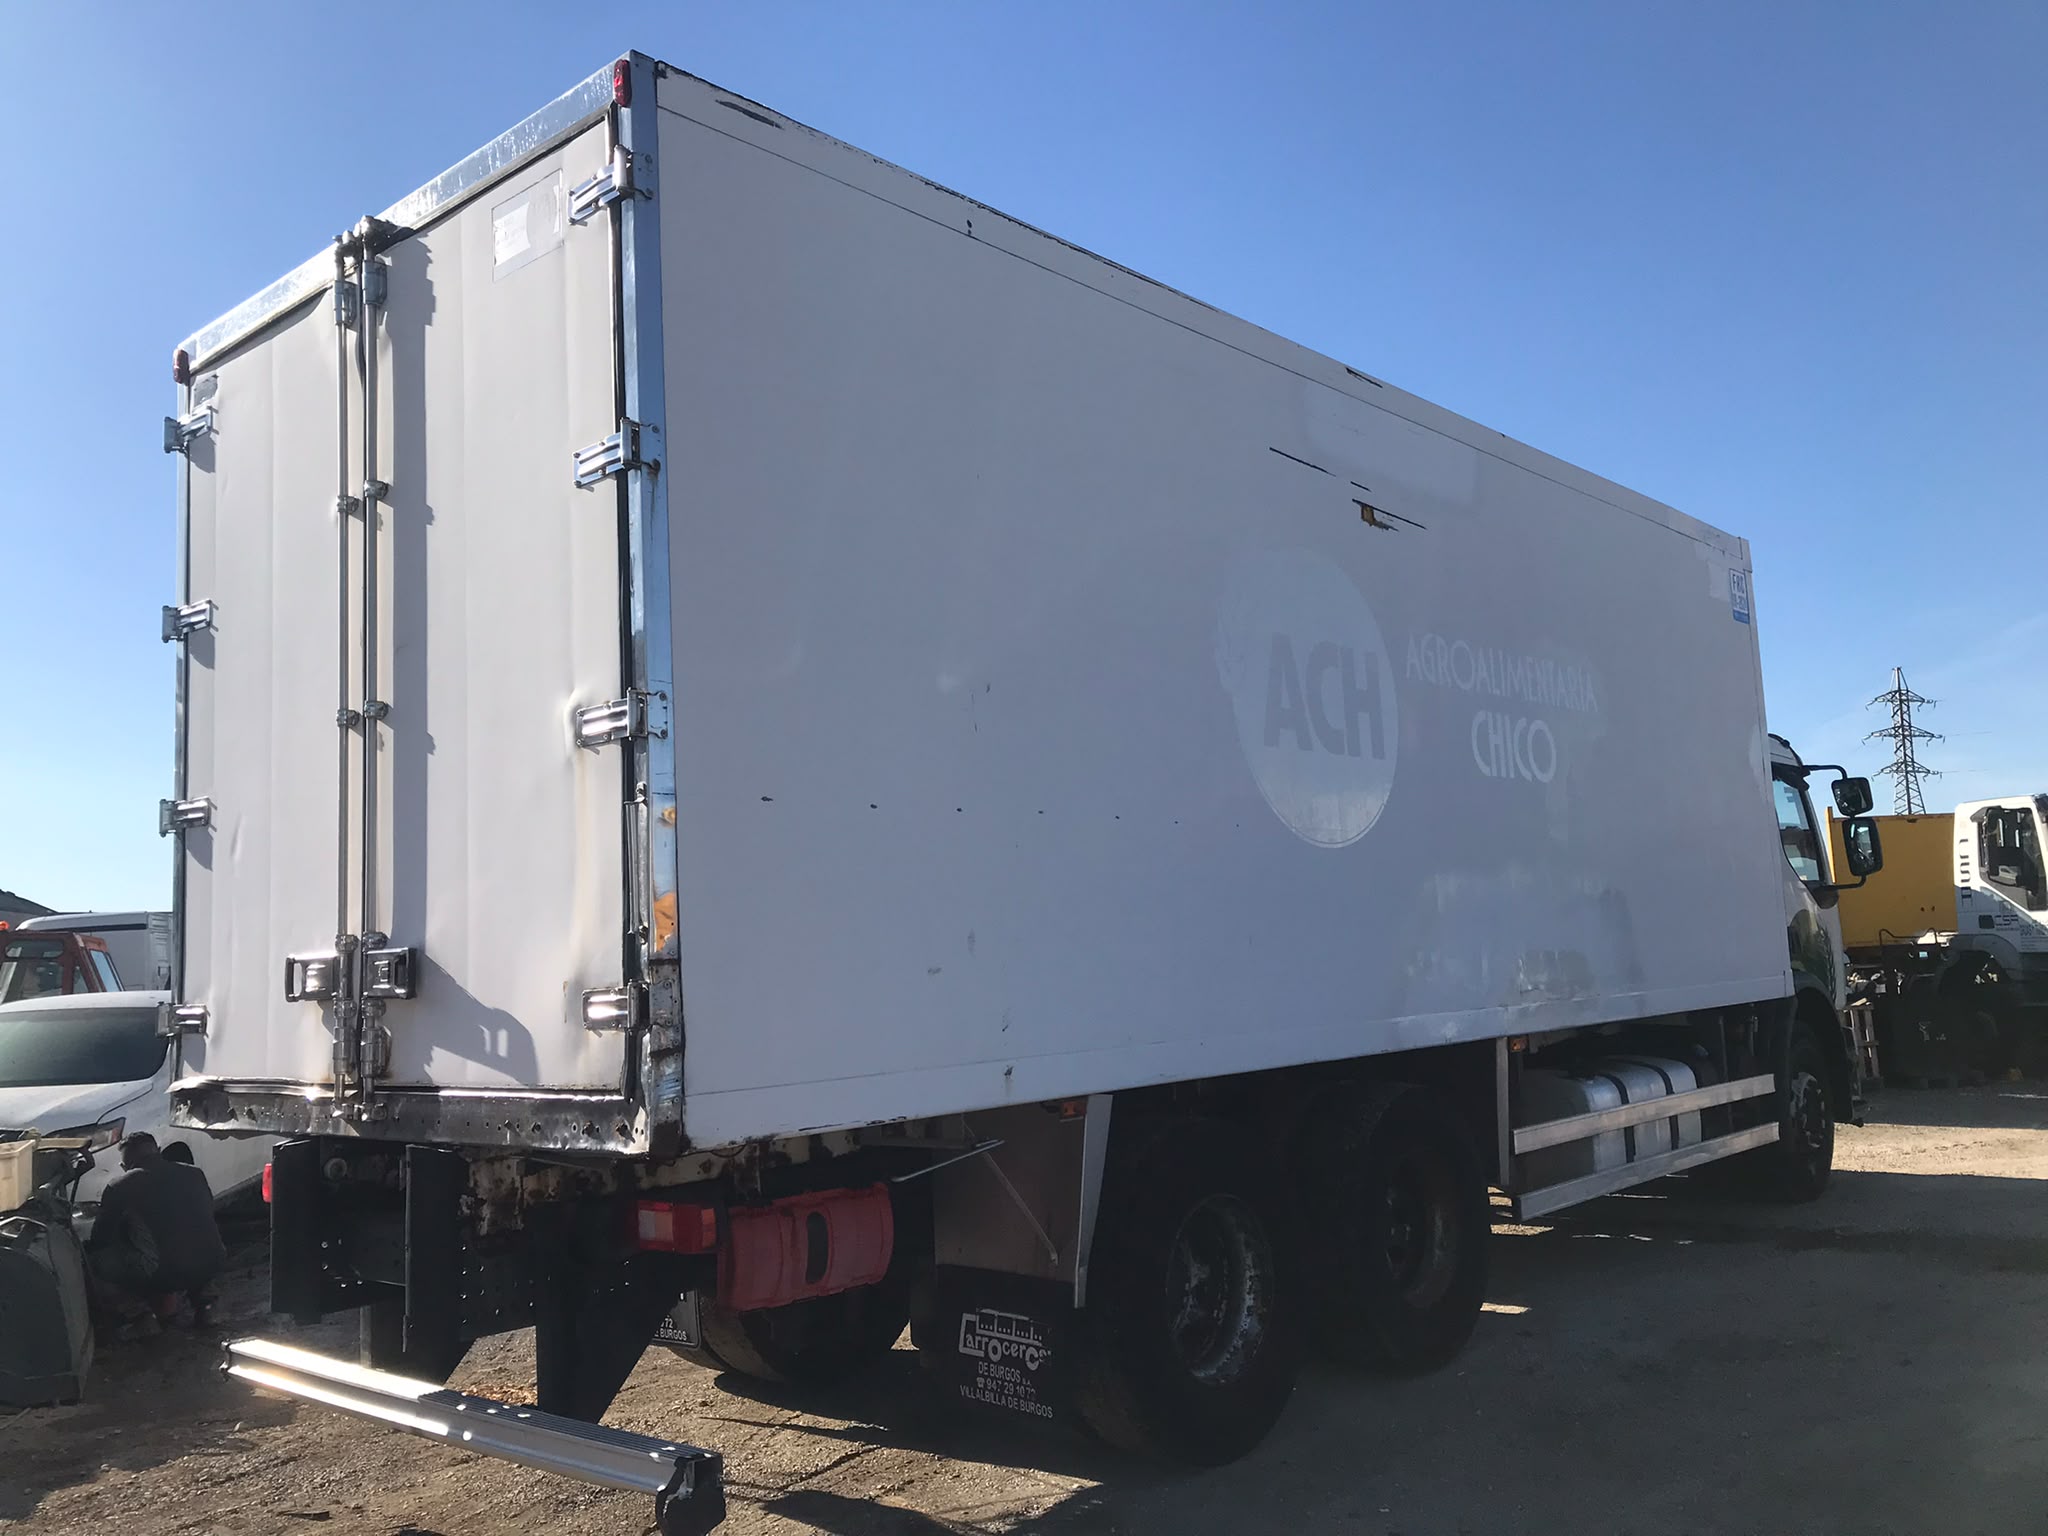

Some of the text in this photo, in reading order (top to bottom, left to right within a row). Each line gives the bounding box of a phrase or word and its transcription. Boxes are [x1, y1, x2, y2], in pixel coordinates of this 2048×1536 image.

[1263, 631, 1386, 761] ACH
[1405, 631, 1600, 713] AGROALIMENTARIA
[1470, 708, 1558, 784] CHICO
[659, 1328, 688, 1341] BURGOS
[978, 1361, 988, 1376] DE
[990, 1364, 1021, 1383] BURGOS
[959, 1384, 1053, 1419] VILLALBILLA DE BURGOS
